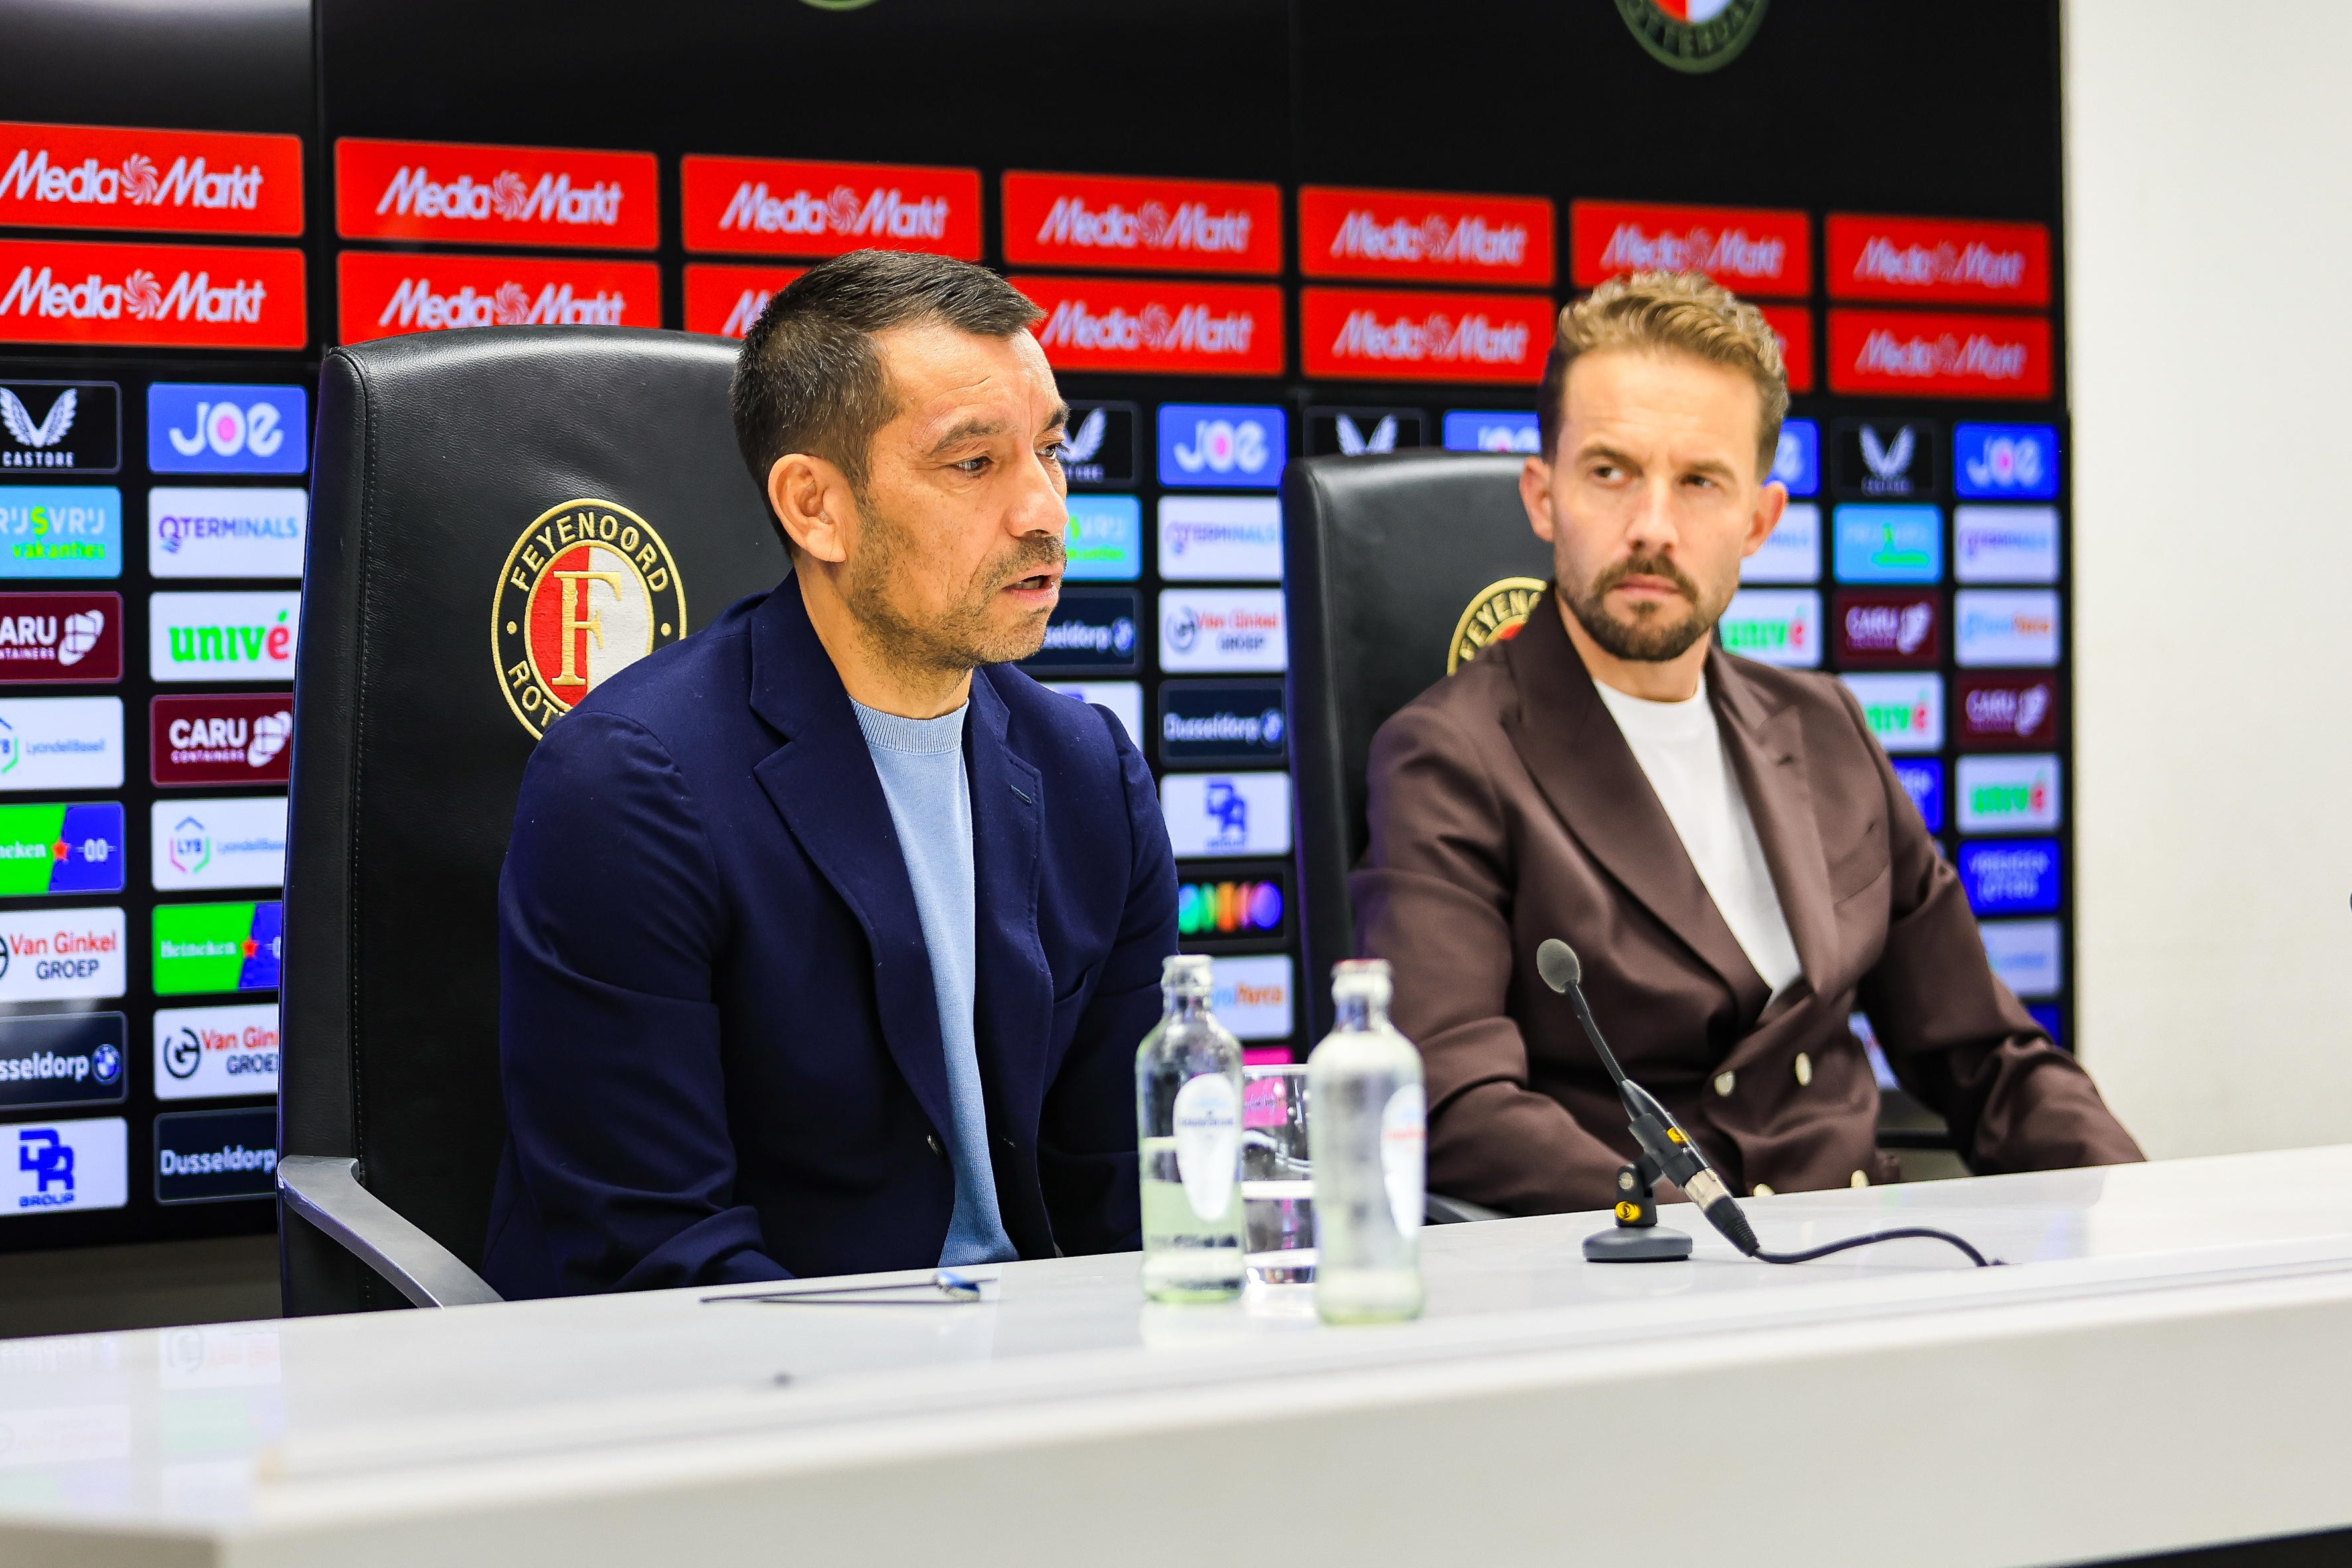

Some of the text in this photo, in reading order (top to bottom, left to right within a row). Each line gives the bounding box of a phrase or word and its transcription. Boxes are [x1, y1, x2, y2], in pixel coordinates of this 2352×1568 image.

[0, 149, 264, 210] Media Markt
[375, 165, 624, 226] Media Markt
[718, 181, 949, 240] Media Markt
[1036, 196, 1253, 254] Media Markt
[0, 266, 266, 324] Media Markt
[378, 277, 625, 328] Media Markt
[2, 451, 75, 467] CASTORE
[510, 511, 668, 592] FEYENOORD
[169, 609, 289, 662] univé
[552, 570, 622, 685] F
[508, 660, 565, 727] ROT
[169, 718, 248, 749] CARU
[1163, 712, 1261, 745] Dusseldorp
[9, 931, 117, 955] Van Ginkel
[37, 959, 99, 980] GROEP
[201, 1026, 279, 1050] Van Gin
[160, 1144, 277, 1175] Dusseldorp
